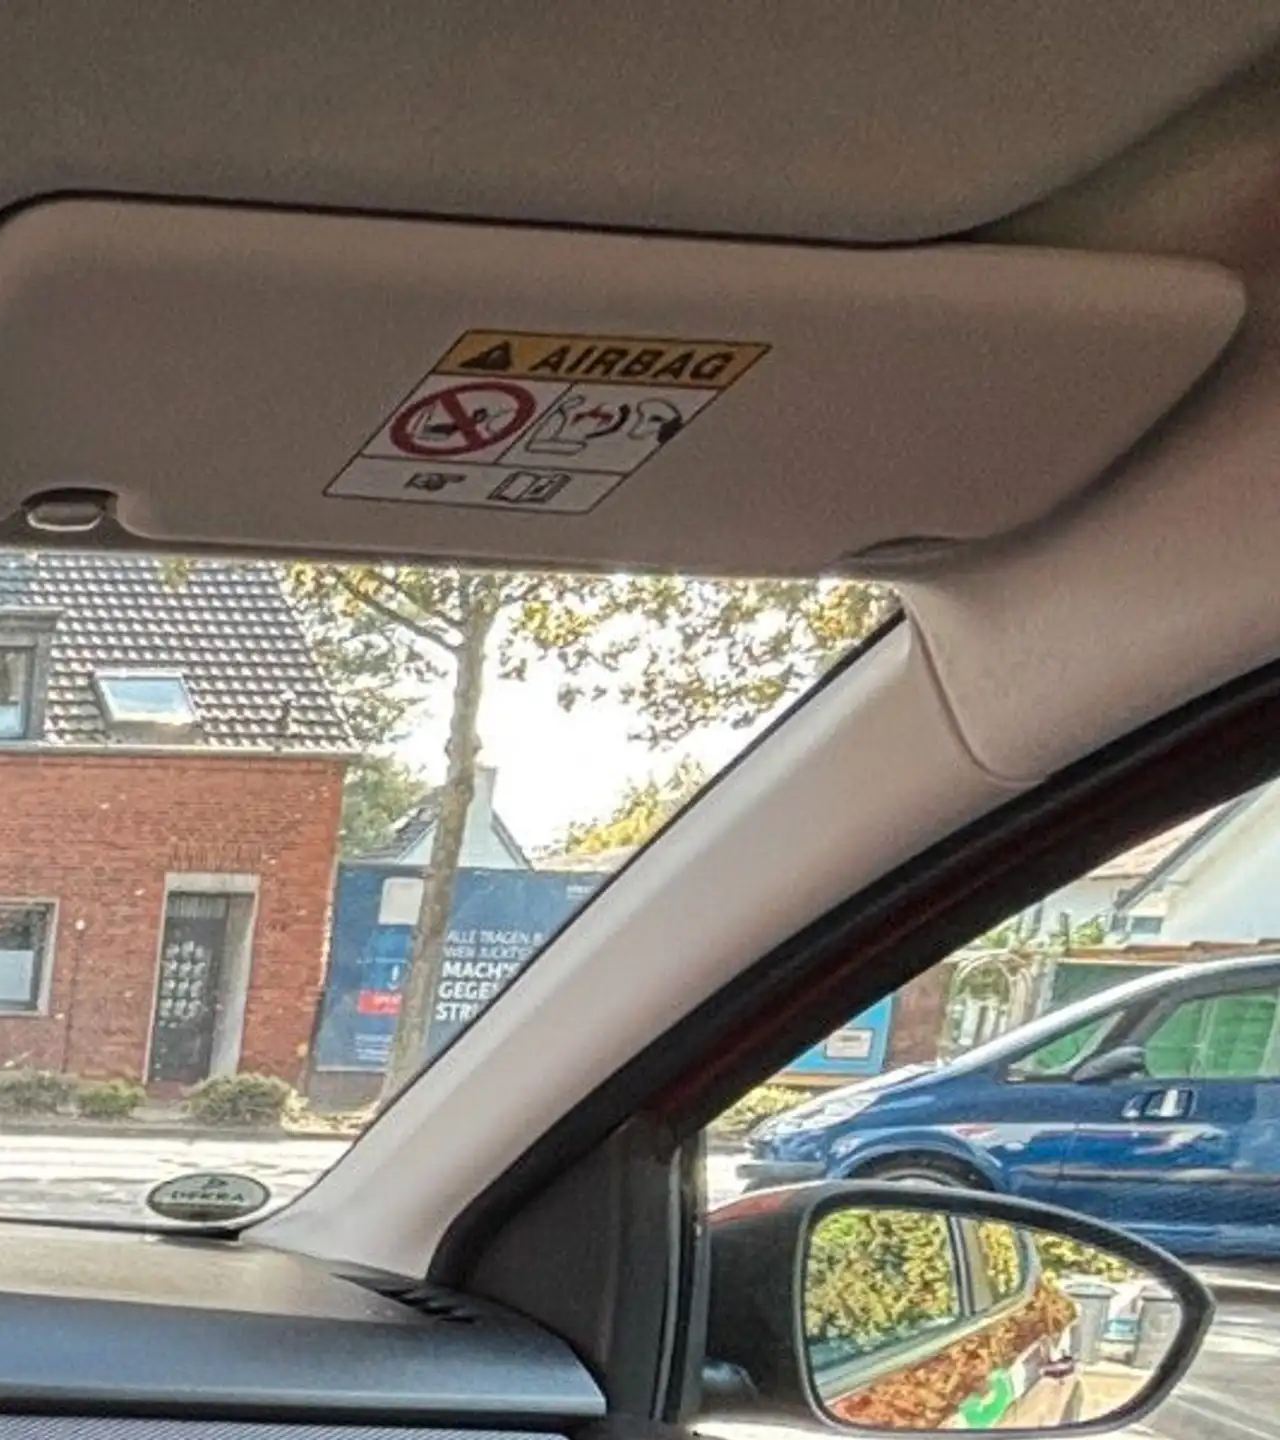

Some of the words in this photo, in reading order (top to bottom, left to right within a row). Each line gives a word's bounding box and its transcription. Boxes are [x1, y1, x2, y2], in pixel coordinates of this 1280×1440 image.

[529, 344, 737, 382] AIRBAG
[437, 981, 500, 1000] GEGE
[435, 1001, 478, 1022] STR
